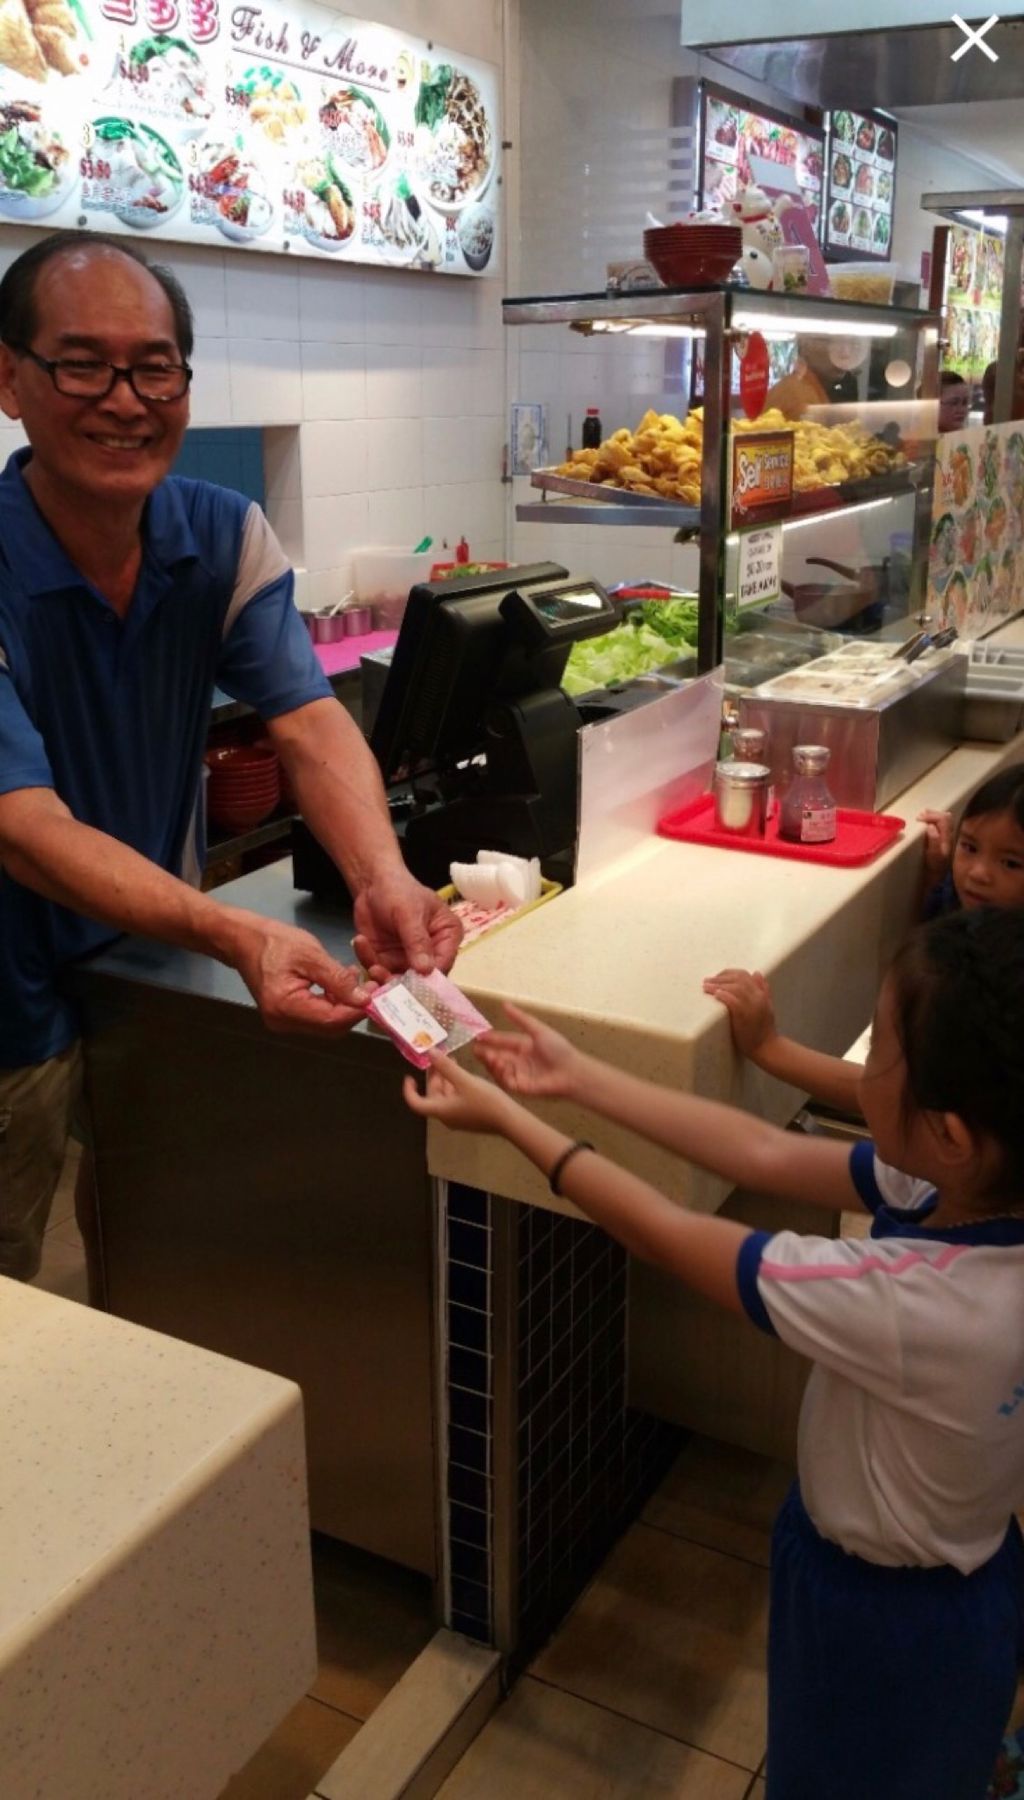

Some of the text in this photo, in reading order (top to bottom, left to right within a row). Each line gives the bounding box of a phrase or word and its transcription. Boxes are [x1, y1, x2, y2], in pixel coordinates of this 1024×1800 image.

[231, 6, 388, 82] Fish & More
